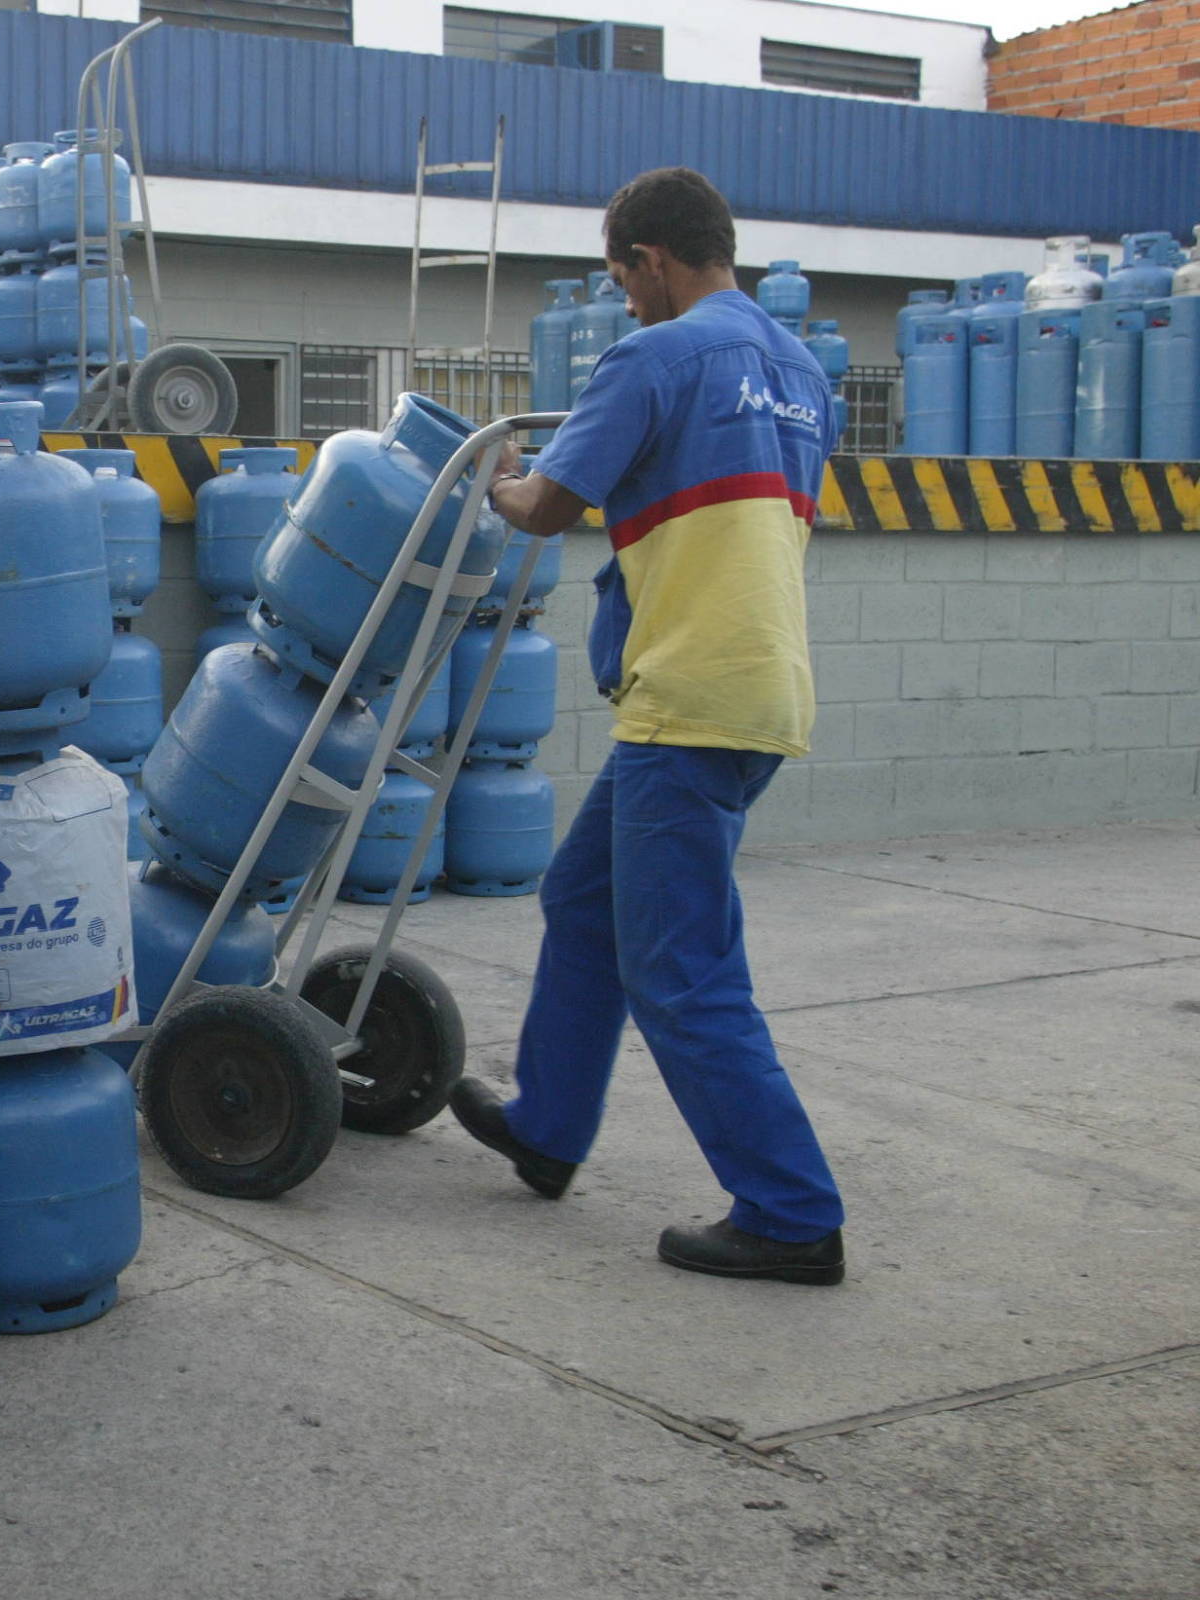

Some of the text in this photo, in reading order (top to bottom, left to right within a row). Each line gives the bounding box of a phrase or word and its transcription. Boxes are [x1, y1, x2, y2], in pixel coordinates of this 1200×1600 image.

[26, 938, 43, 950] do
[46, 932, 79, 951] grupo
[24, 1005, 97, 1027] ULTRAGAZ
